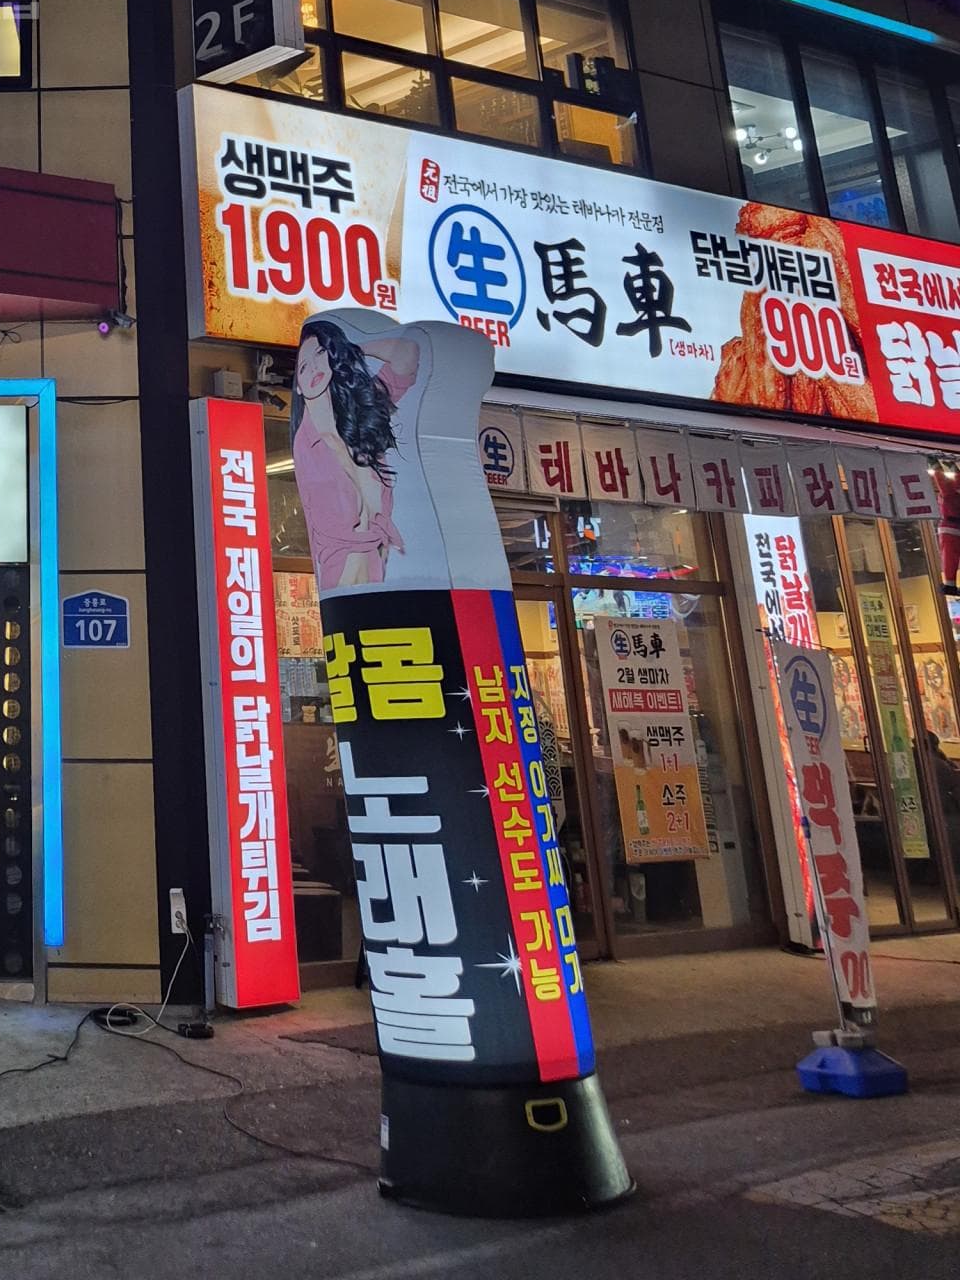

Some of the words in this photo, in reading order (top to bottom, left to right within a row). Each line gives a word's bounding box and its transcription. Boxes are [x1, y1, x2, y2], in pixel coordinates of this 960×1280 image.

[221, 139, 355, 214] 생맥주
[443, 175, 498, 201] 전국에서
[501, 186, 527, 209] 가장
[531, 191, 570, 215] 맛있는
[628, 210, 664, 233] 전문점
[690, 231, 837, 302] 닭날개튀김
[219, 448, 257, 536] 전국
[75, 619, 117, 641] 107
[225, 547, 265, 683] 제일의
[323, 627, 446, 723] 달콤
[646, 726, 685, 747] 생맥주
[233, 696, 282, 942] 닭날개튀김
[662, 784, 687, 806] 소주
[666, 811, 690, 832] 2+1
[473, 665, 513, 744] 남자
[494, 761, 542, 891] 선수도
[520, 910, 562, 1001] 가능
[339, 741, 476, 1062] 노래홀
